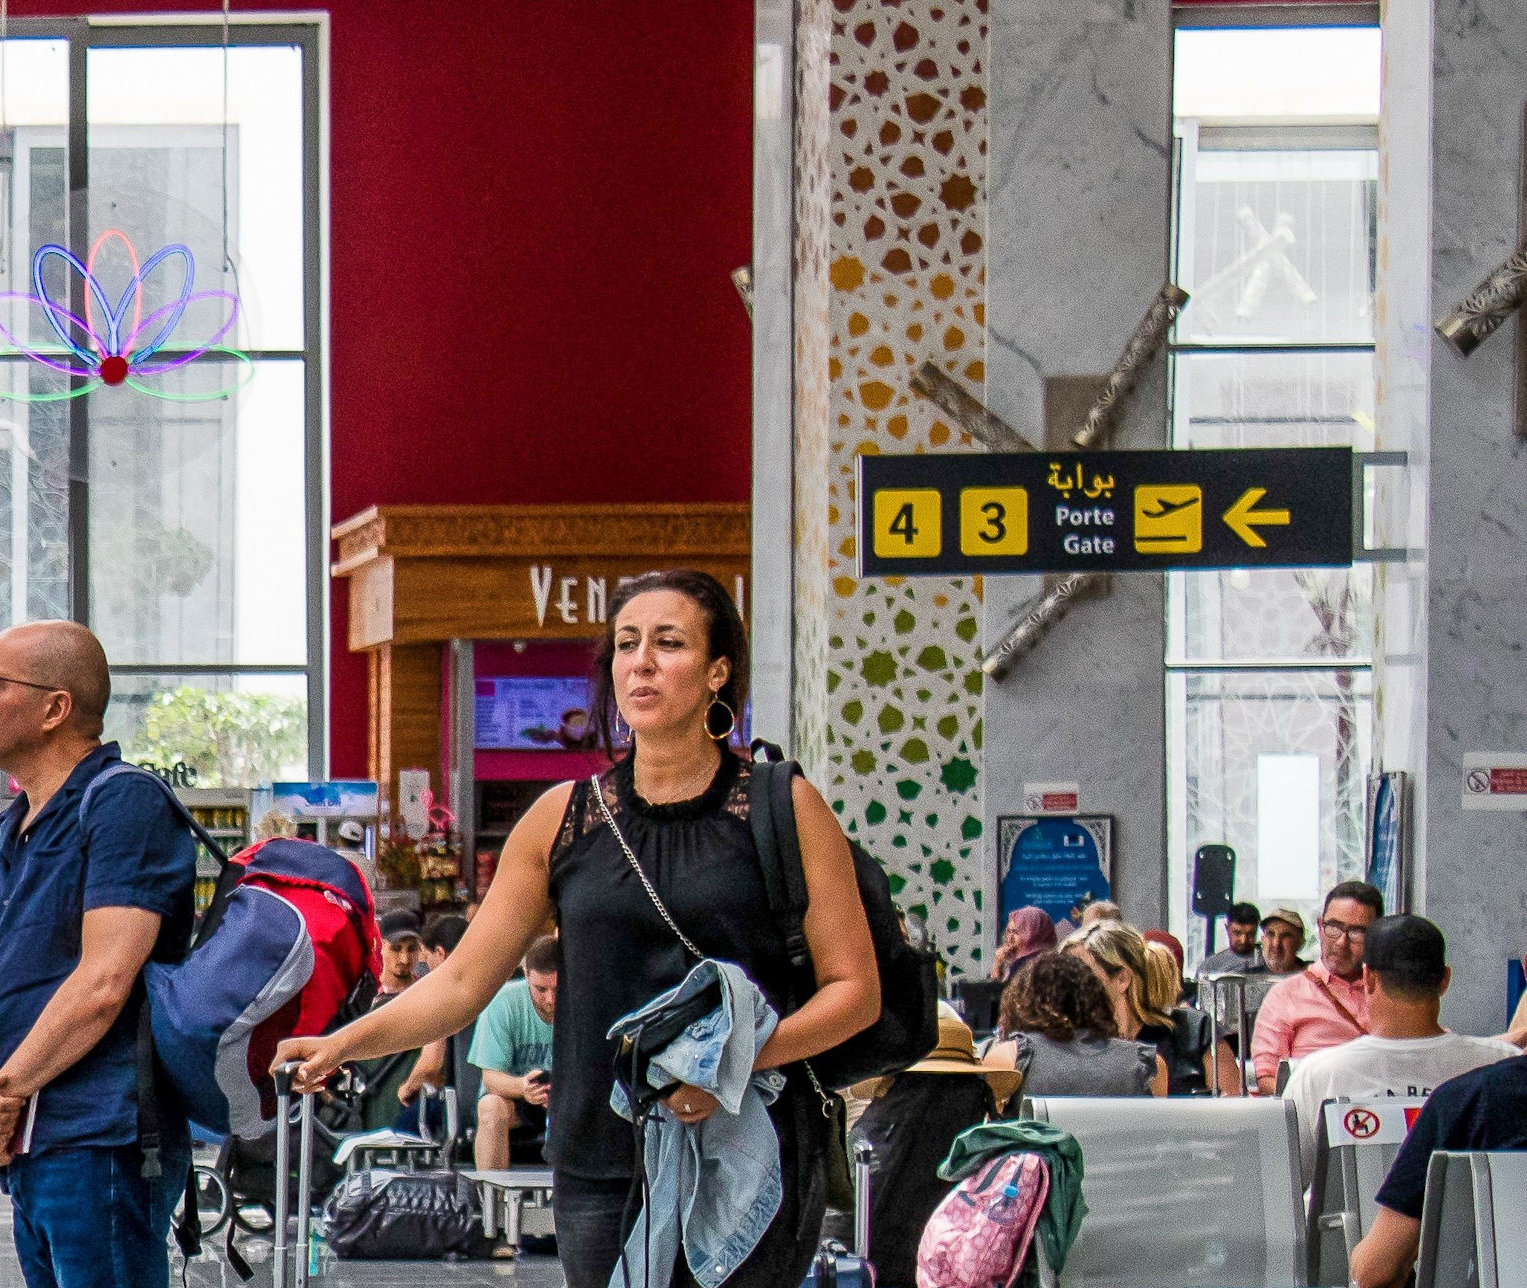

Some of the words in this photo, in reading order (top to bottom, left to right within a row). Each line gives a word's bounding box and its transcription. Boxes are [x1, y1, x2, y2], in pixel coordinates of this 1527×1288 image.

[1048, 462, 1115, 499] بوابة
[889, 503, 919, 545] 4
[978, 501, 1007, 543] 3
[1056, 506, 1114, 526] Porte
[1064, 535, 1115, 555] Gate
